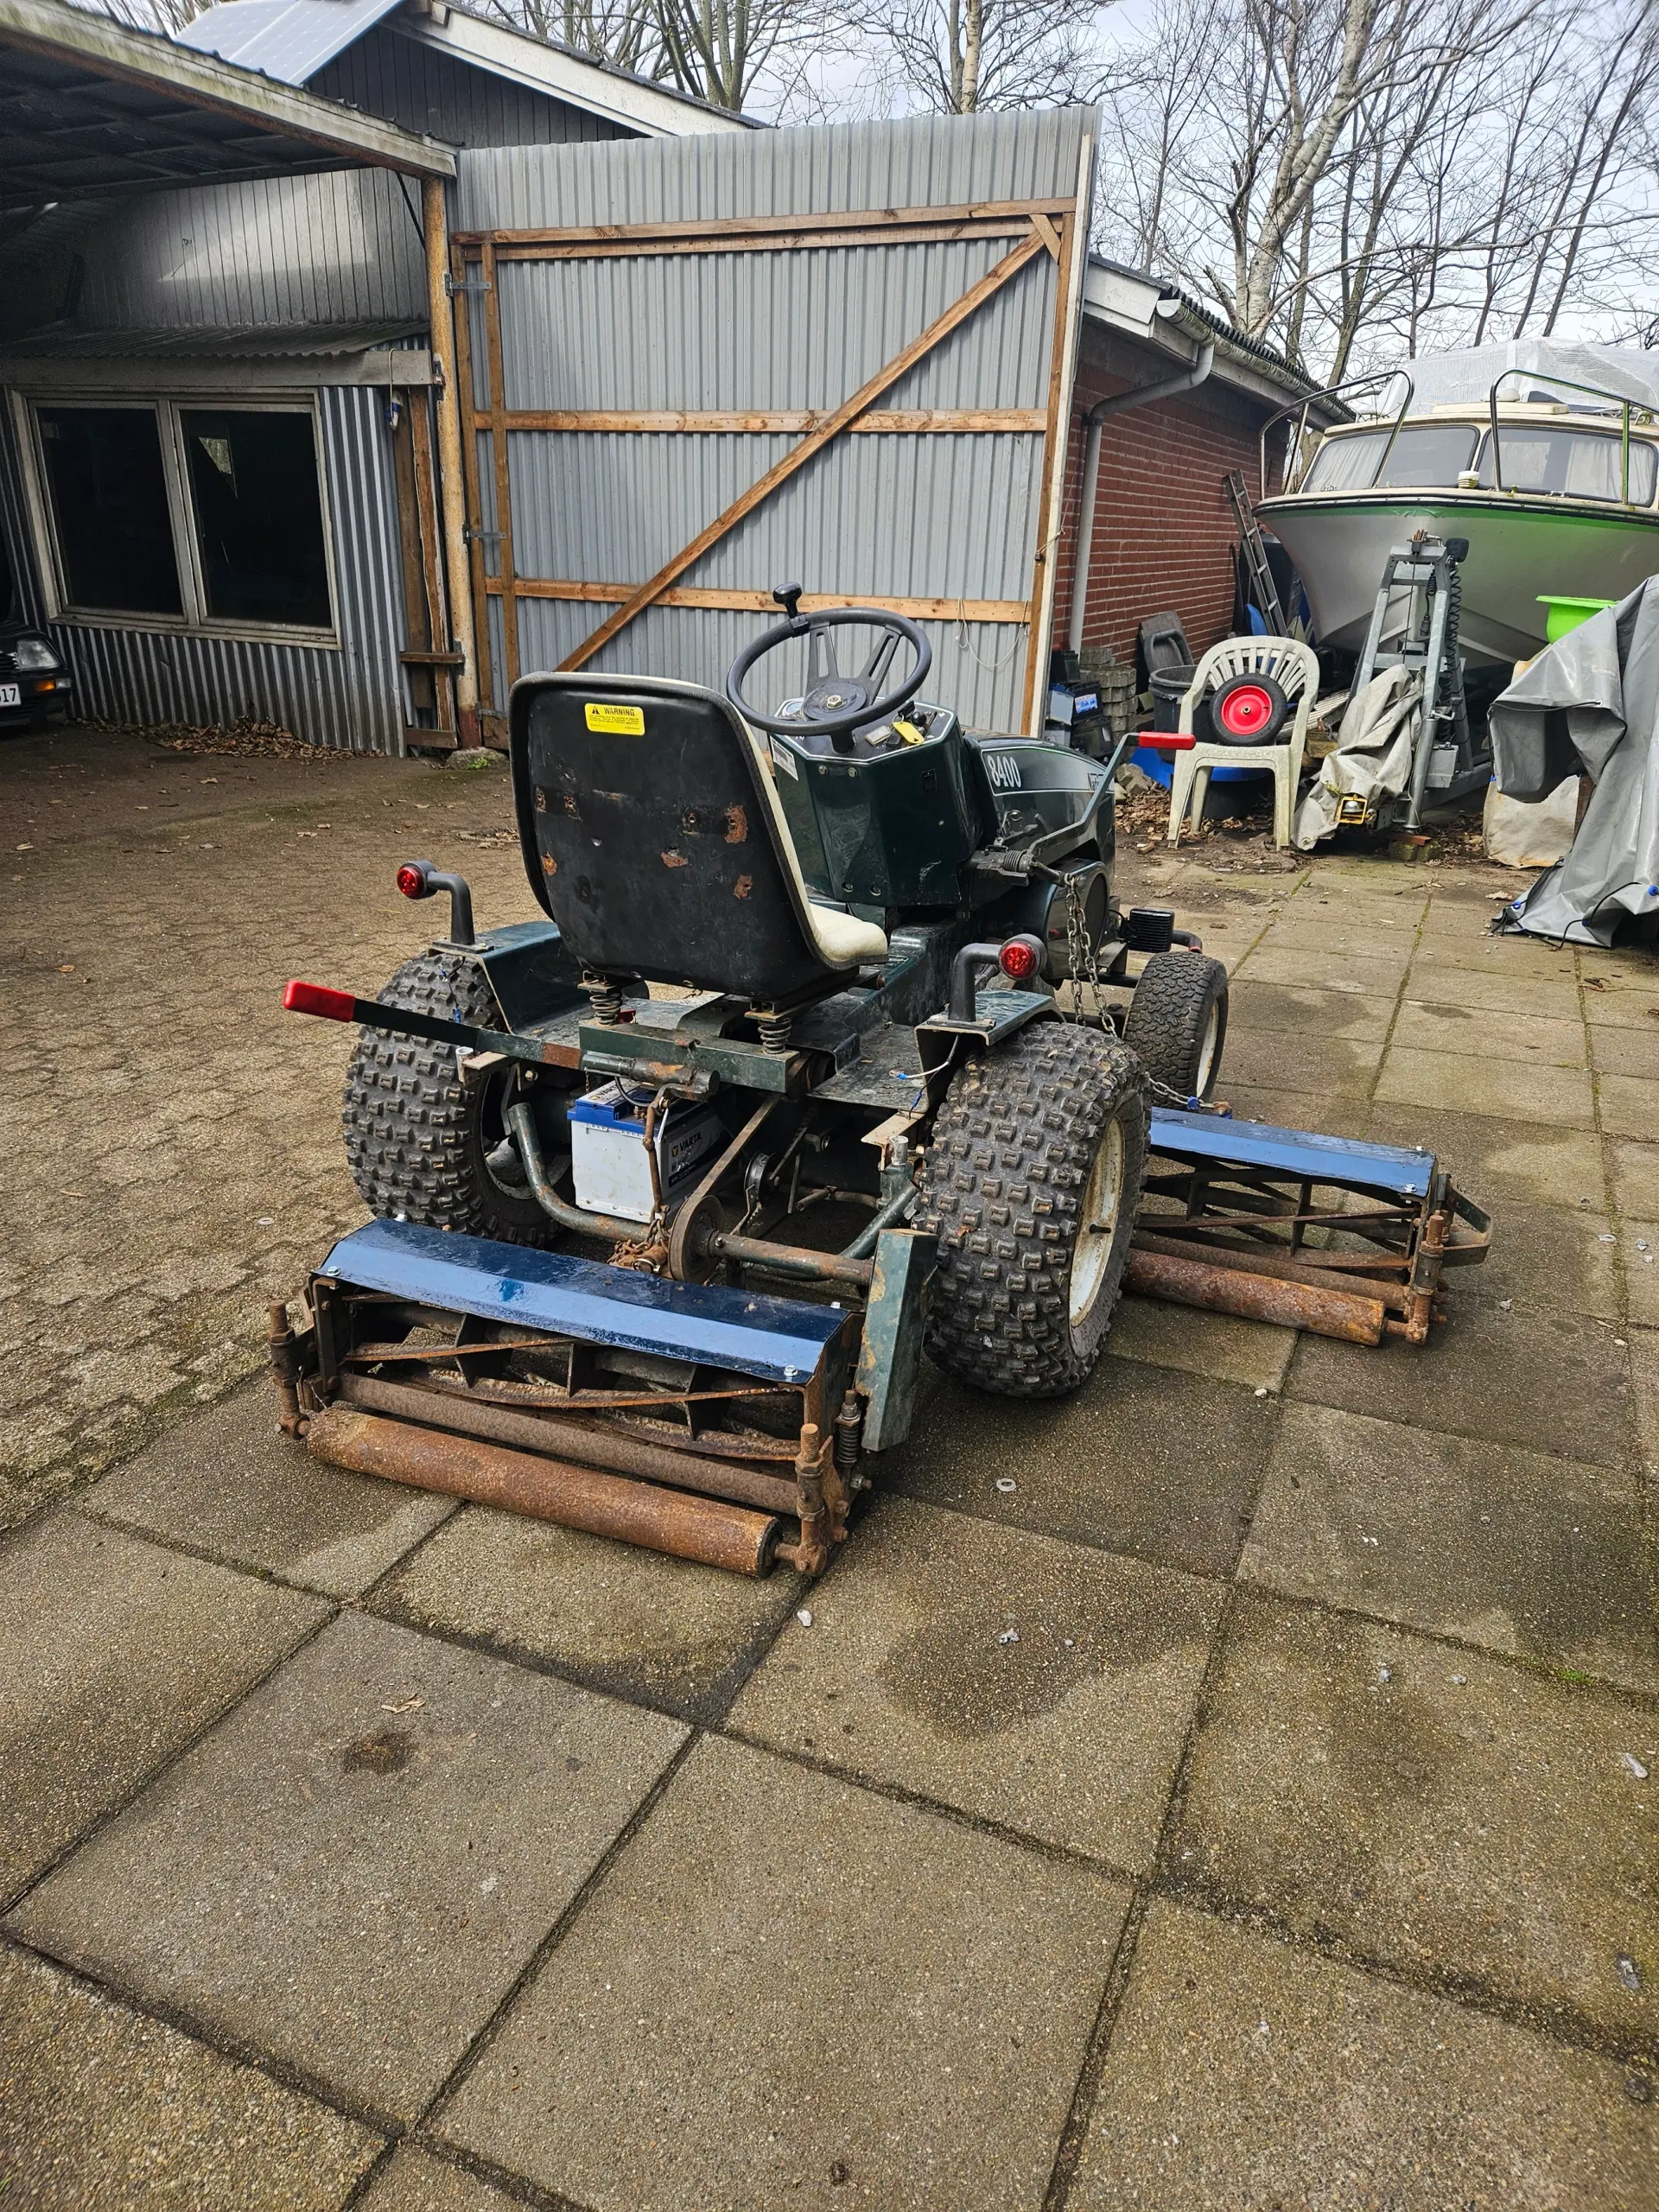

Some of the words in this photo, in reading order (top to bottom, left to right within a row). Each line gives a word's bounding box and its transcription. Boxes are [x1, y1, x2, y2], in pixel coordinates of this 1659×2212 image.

[0, 688, 16, 702] 17
[604, 707, 635, 716] WARNING
[987, 754, 1021, 788] 8400
[679, 1132, 702, 1152] VARTA
